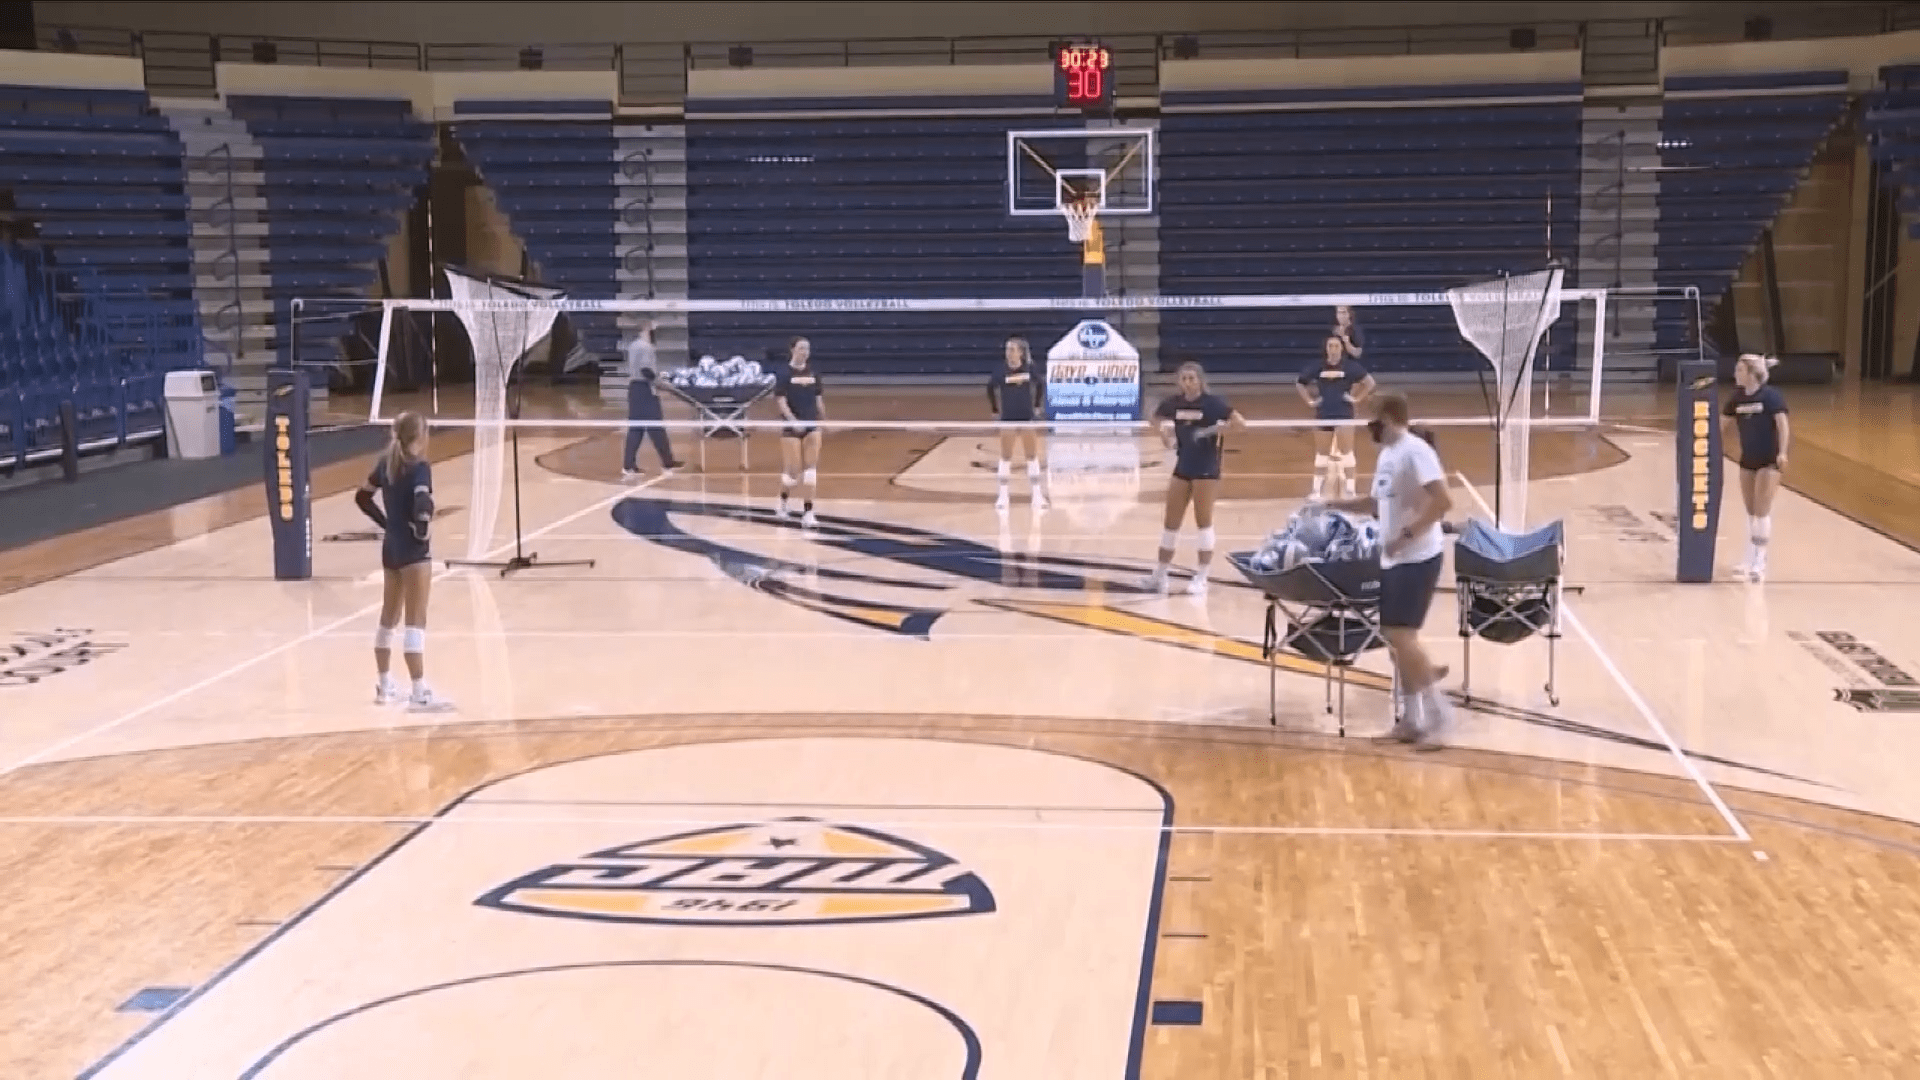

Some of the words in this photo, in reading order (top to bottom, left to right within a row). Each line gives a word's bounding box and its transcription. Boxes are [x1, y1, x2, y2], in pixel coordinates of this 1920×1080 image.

[1069, 69, 1101, 98] 30
[481, 300, 527, 309] TOLEDO
[530, 300, 602, 309] VOLLEYBALL
[785, 299, 832, 309] TOLEDO
[834, 299, 909, 309] VOLLEYBALL
[1096, 297, 1145, 306] TOLEDO
[1148, 296, 1223, 305] VOLLEYBALL
[275, 416, 293, 520] TOLEDO
[1692, 400, 1710, 530] ROCKETS
[660, 899, 798, 912] 1946
